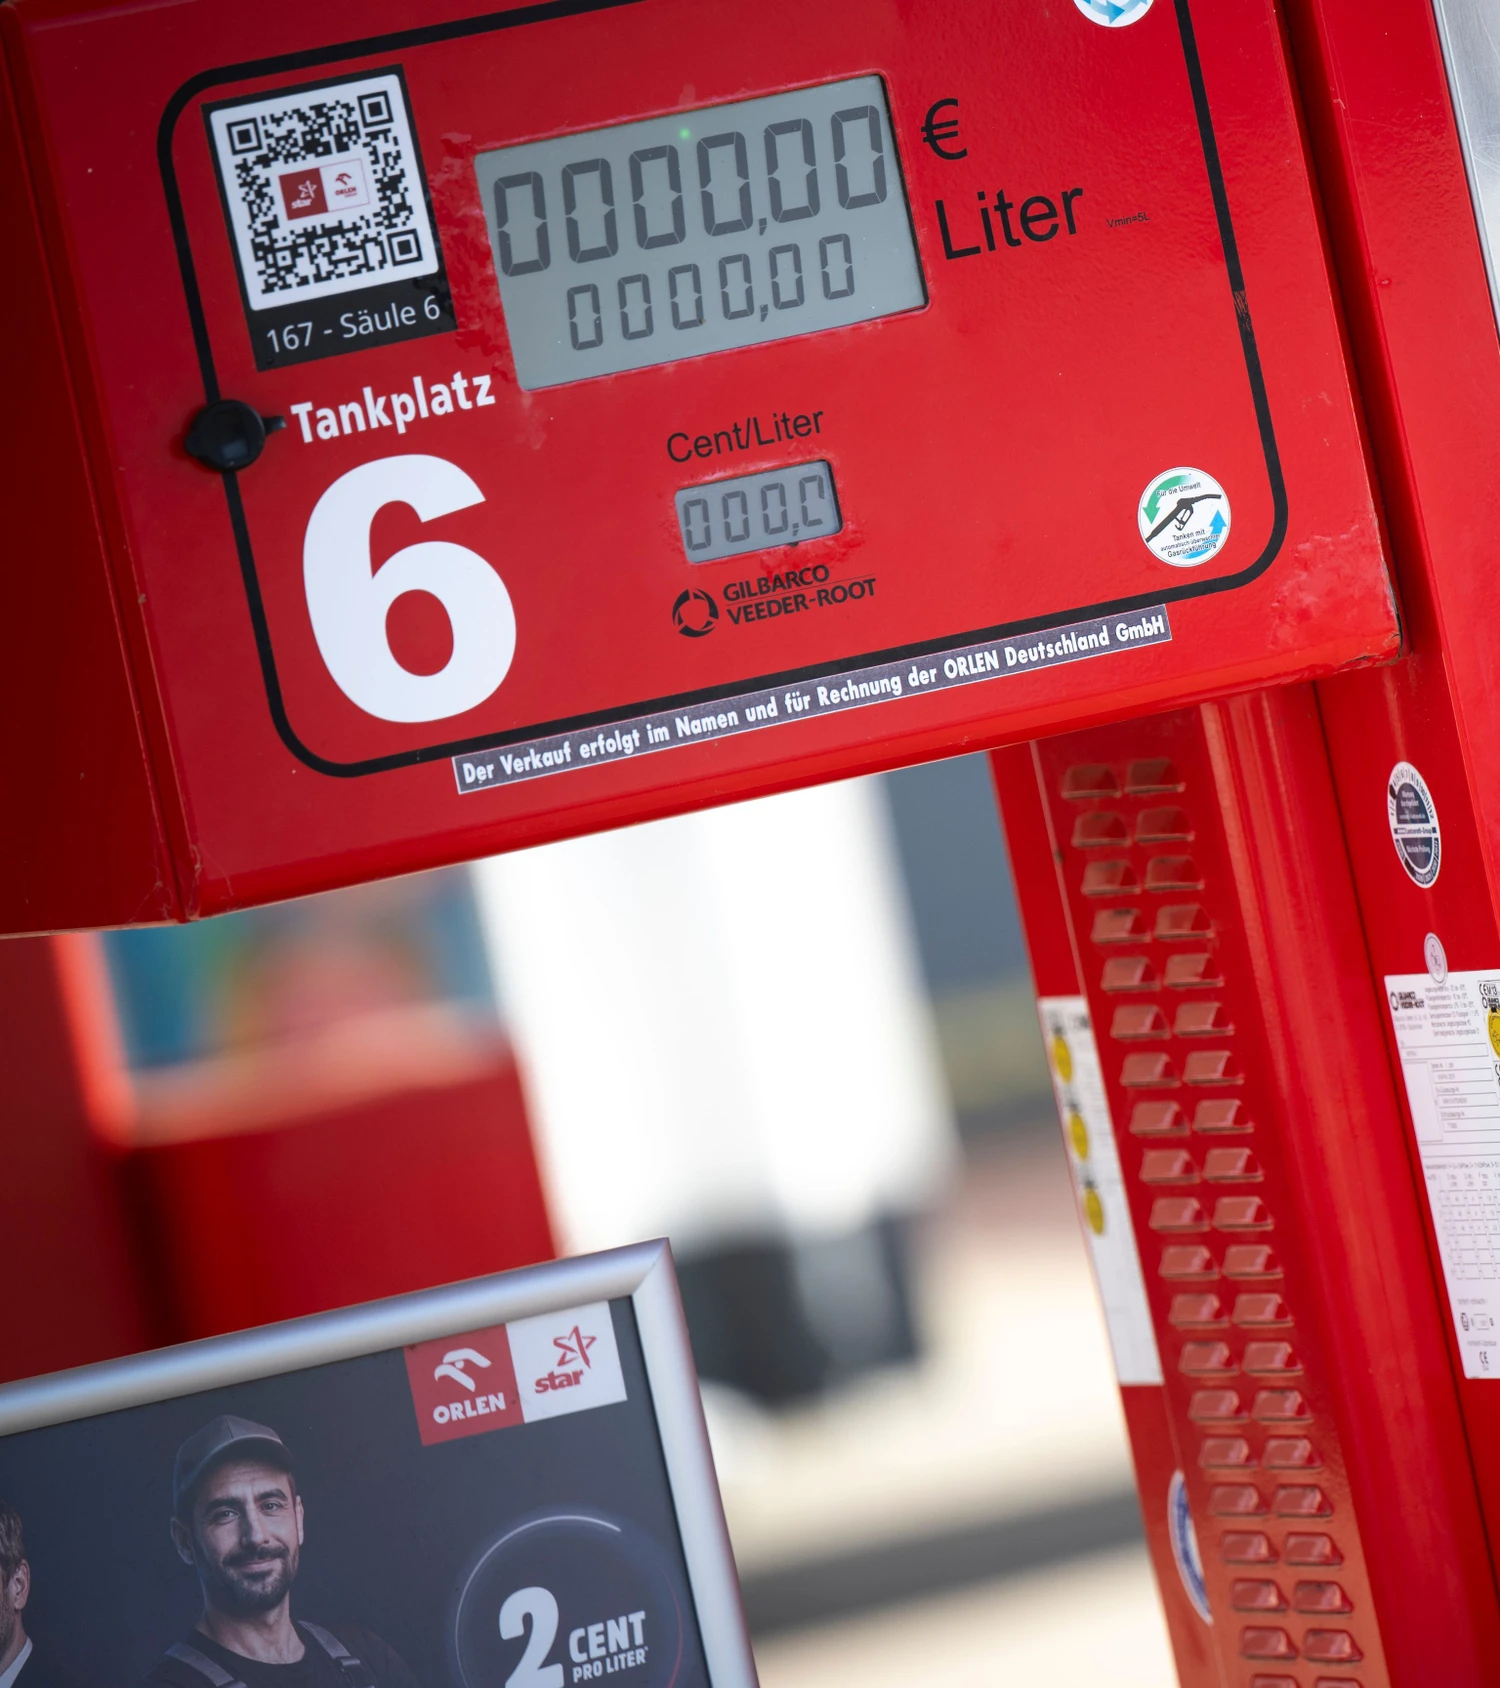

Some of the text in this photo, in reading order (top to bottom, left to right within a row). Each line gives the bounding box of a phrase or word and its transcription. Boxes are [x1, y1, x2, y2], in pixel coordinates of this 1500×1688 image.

[921, 98, 968, 160] €
[935, 187, 1083, 260] Liter
[1106, 212, 1150, 228] Vmin=5L
[267, 321, 314, 352] 167
[339, 302, 417, 338] Säule
[423, 295, 440, 320] 6
[290, 371, 496, 443] Tankplatz
[667, 410, 824, 463] Cent/Liter
[1172, 528, 1206, 541] Tanken mit
[303, 454, 517, 723] 6
[723, 564, 830, 602] GILBARCO
[726, 578, 877, 625] VEEDER-ROOT
[463, 614, 1166, 784] Der Verkauf erfolgt im Namen und für Rechnung der ORLEN Deutschland GmbH
[534, 1367, 584, 1394] star
[433, 1391, 506, 1424] ORLEN
[499, 1586, 646, 1688] 2 CENT
[572, 1661, 601, 1683] PRO
